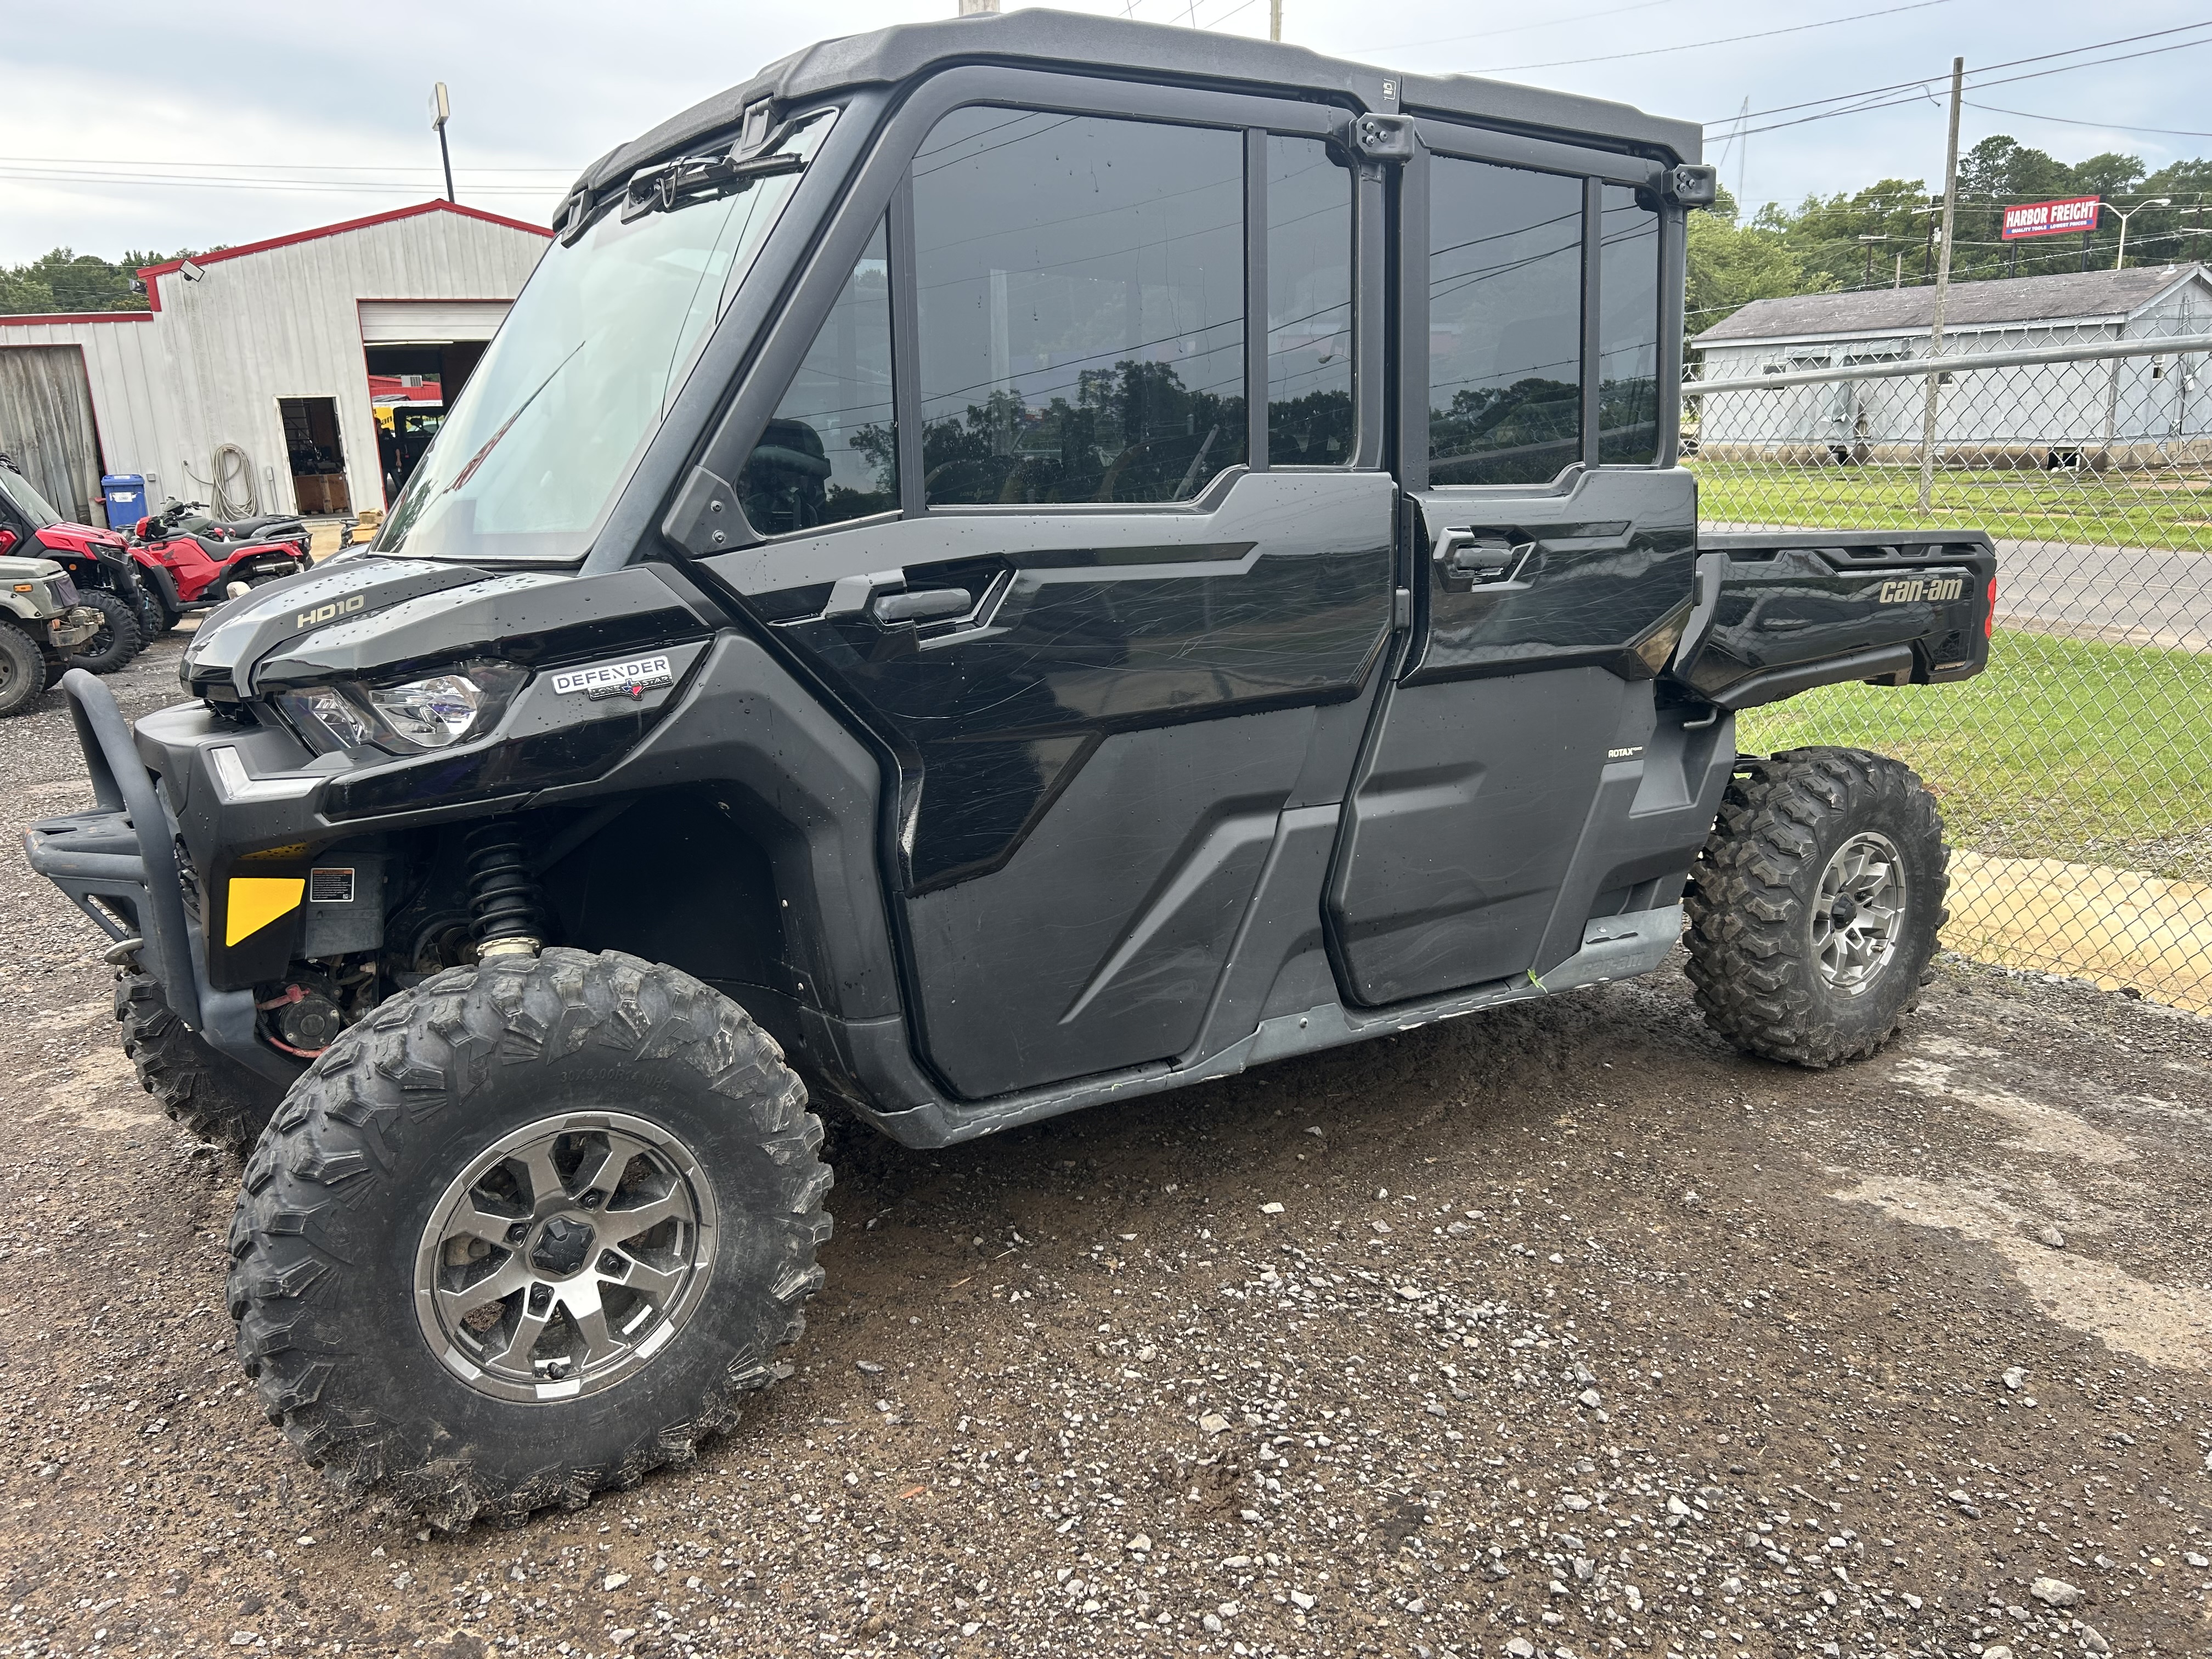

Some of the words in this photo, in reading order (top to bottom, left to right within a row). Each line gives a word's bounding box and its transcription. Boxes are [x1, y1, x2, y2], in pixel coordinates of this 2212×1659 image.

[2006, 207, 2049, 228] HARBOR
[2050, 200, 2096, 222] FREIGHT
[1879, 579, 1963, 603] can-am
[297, 595, 364, 629] HD10
[557, 659, 667, 690] DEFENDER
[592, 685, 620, 696] LONE
[641, 676, 669, 686] STAR
[1608, 747, 1633, 758] ROTAX
